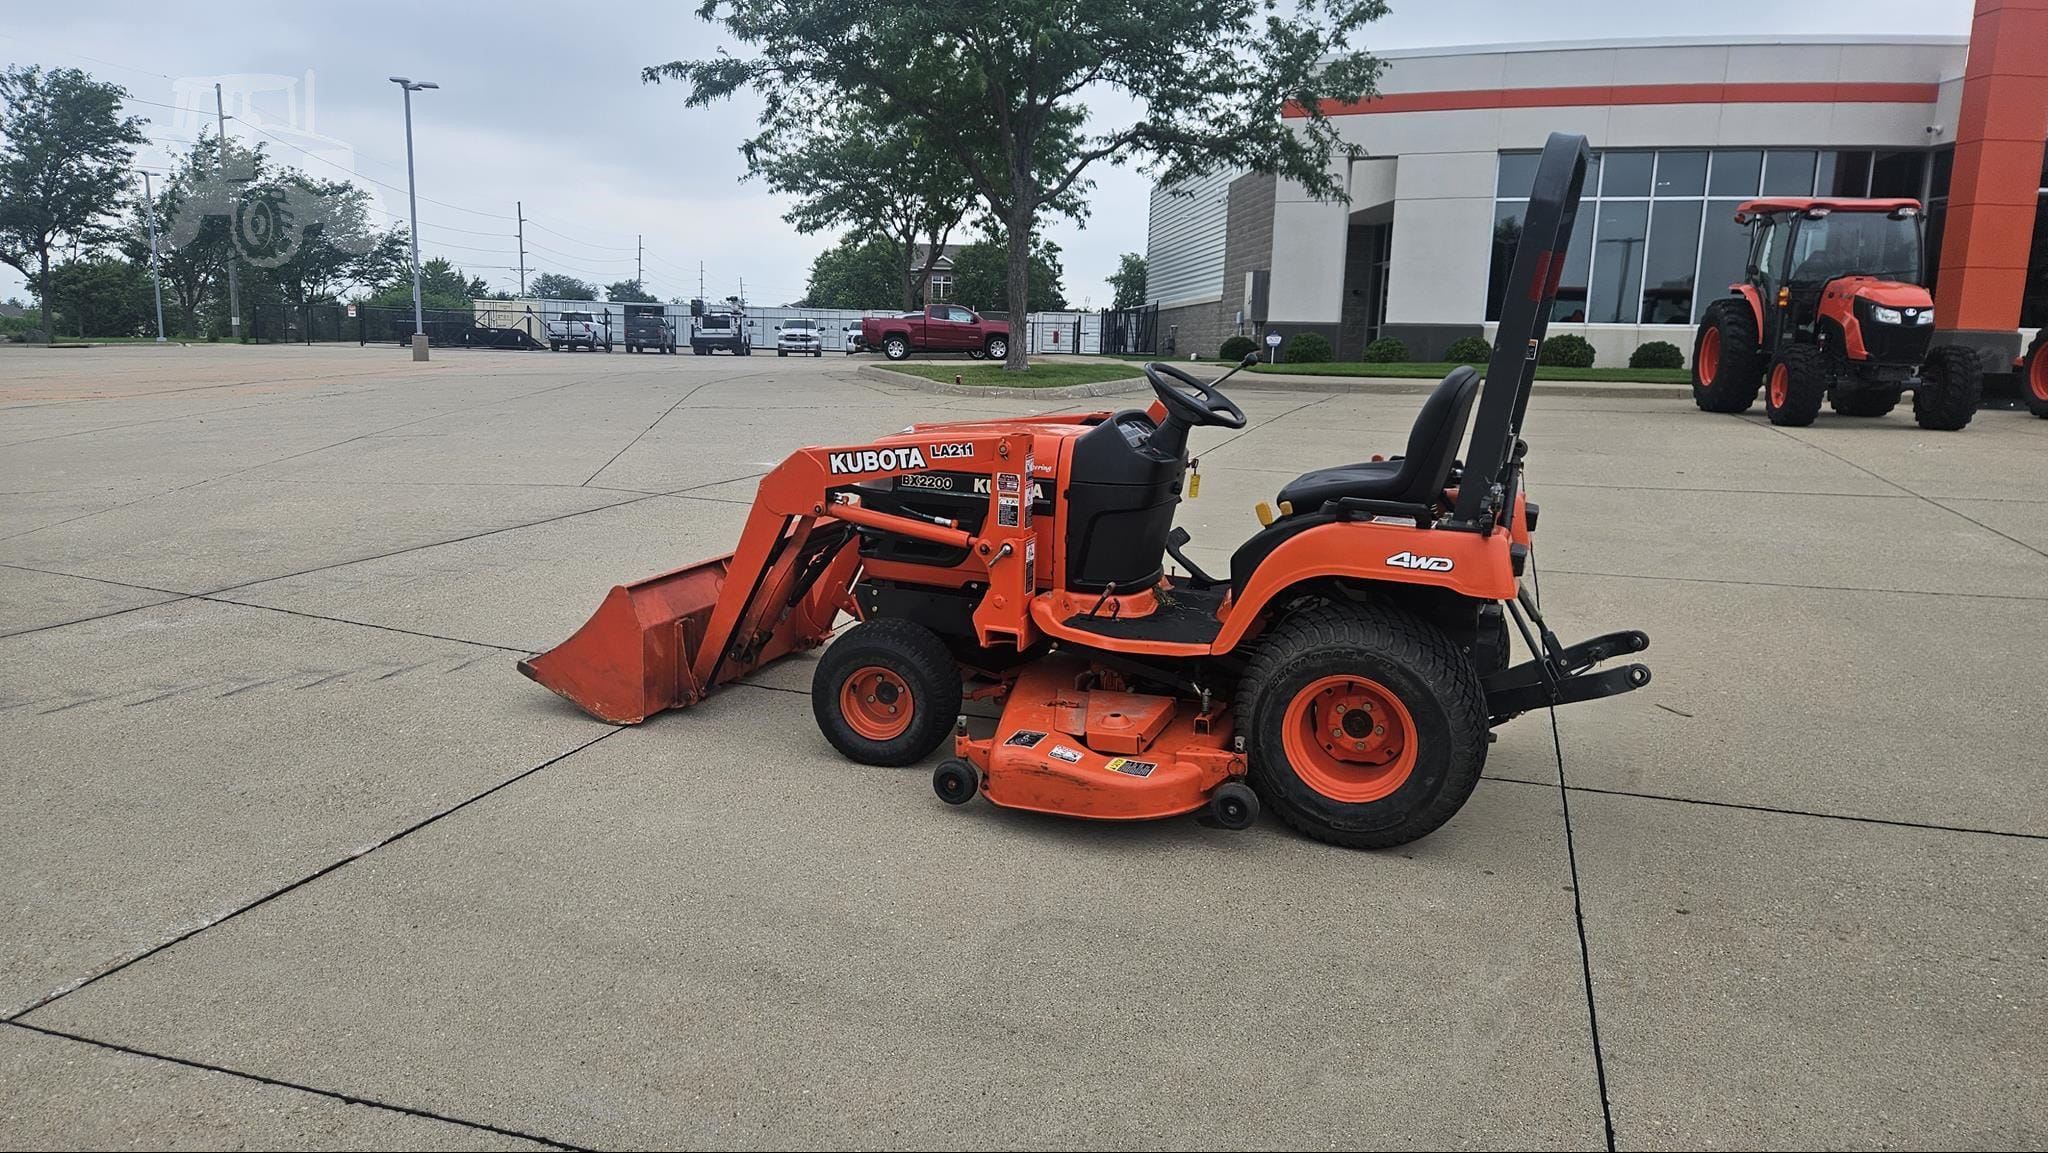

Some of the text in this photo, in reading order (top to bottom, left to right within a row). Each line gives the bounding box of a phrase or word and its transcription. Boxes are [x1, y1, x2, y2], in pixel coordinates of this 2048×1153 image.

[930, 443, 973, 458] LA211
[830, 447, 927, 474] KUBOTA
[902, 475, 953, 489] BX2200
[1386, 551, 1454, 572] 4WD
